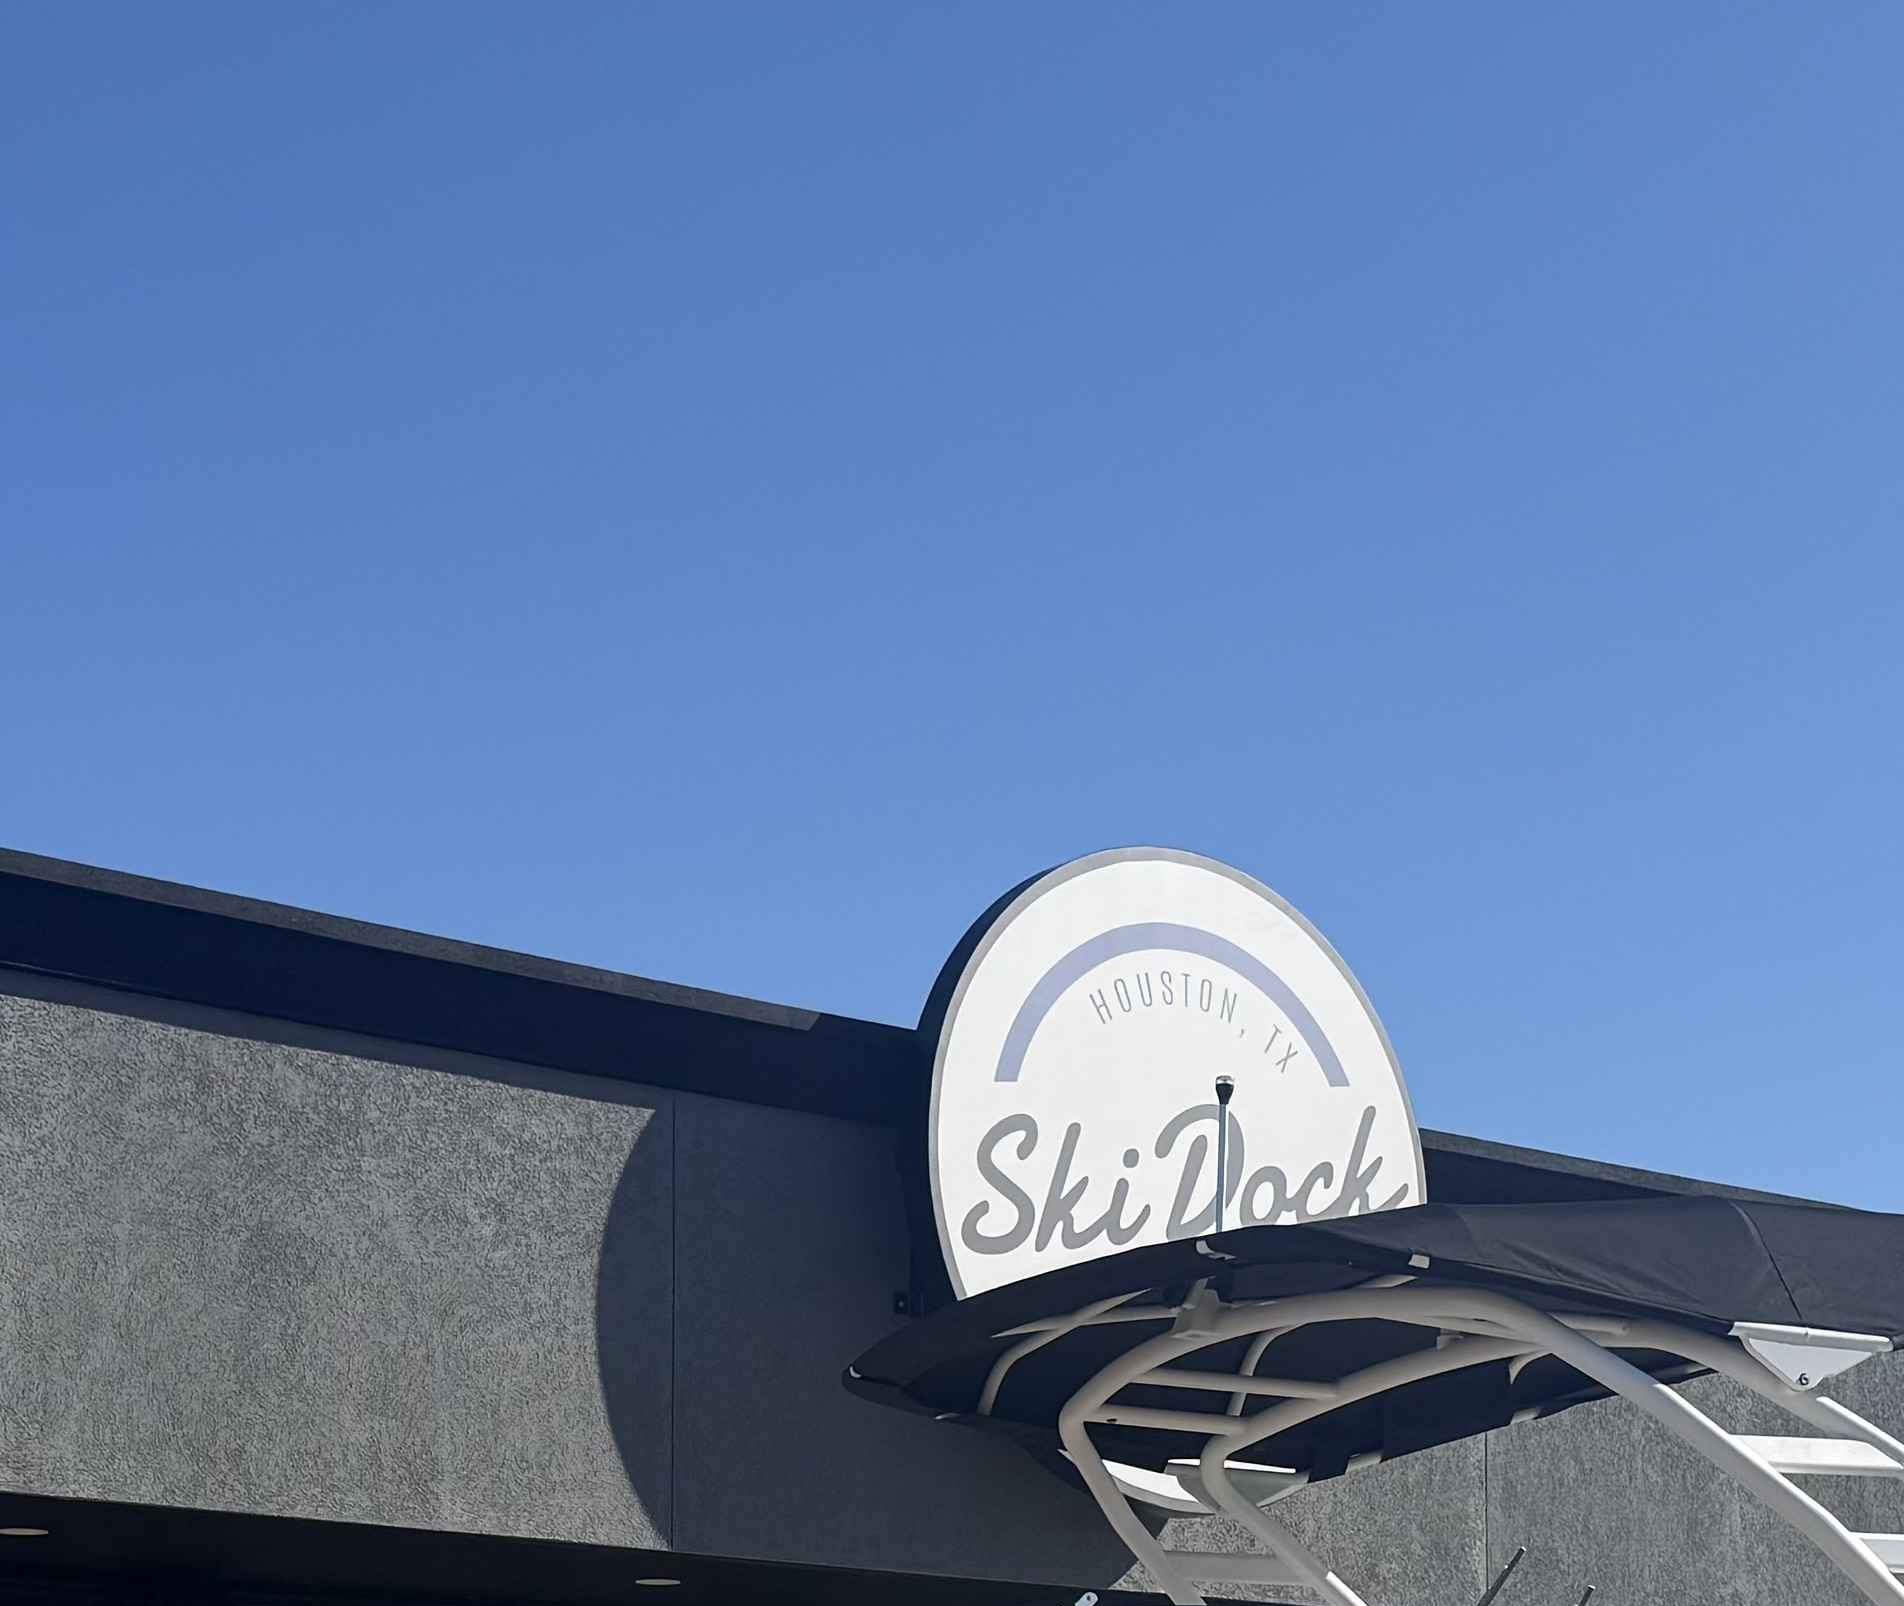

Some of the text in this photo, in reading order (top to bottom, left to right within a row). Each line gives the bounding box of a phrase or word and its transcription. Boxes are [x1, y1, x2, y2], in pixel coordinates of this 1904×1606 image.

[1089, 970, 1299, 1074] HOUSTON, TX
[961, 1103, 1410, 1256] Ski Dock
